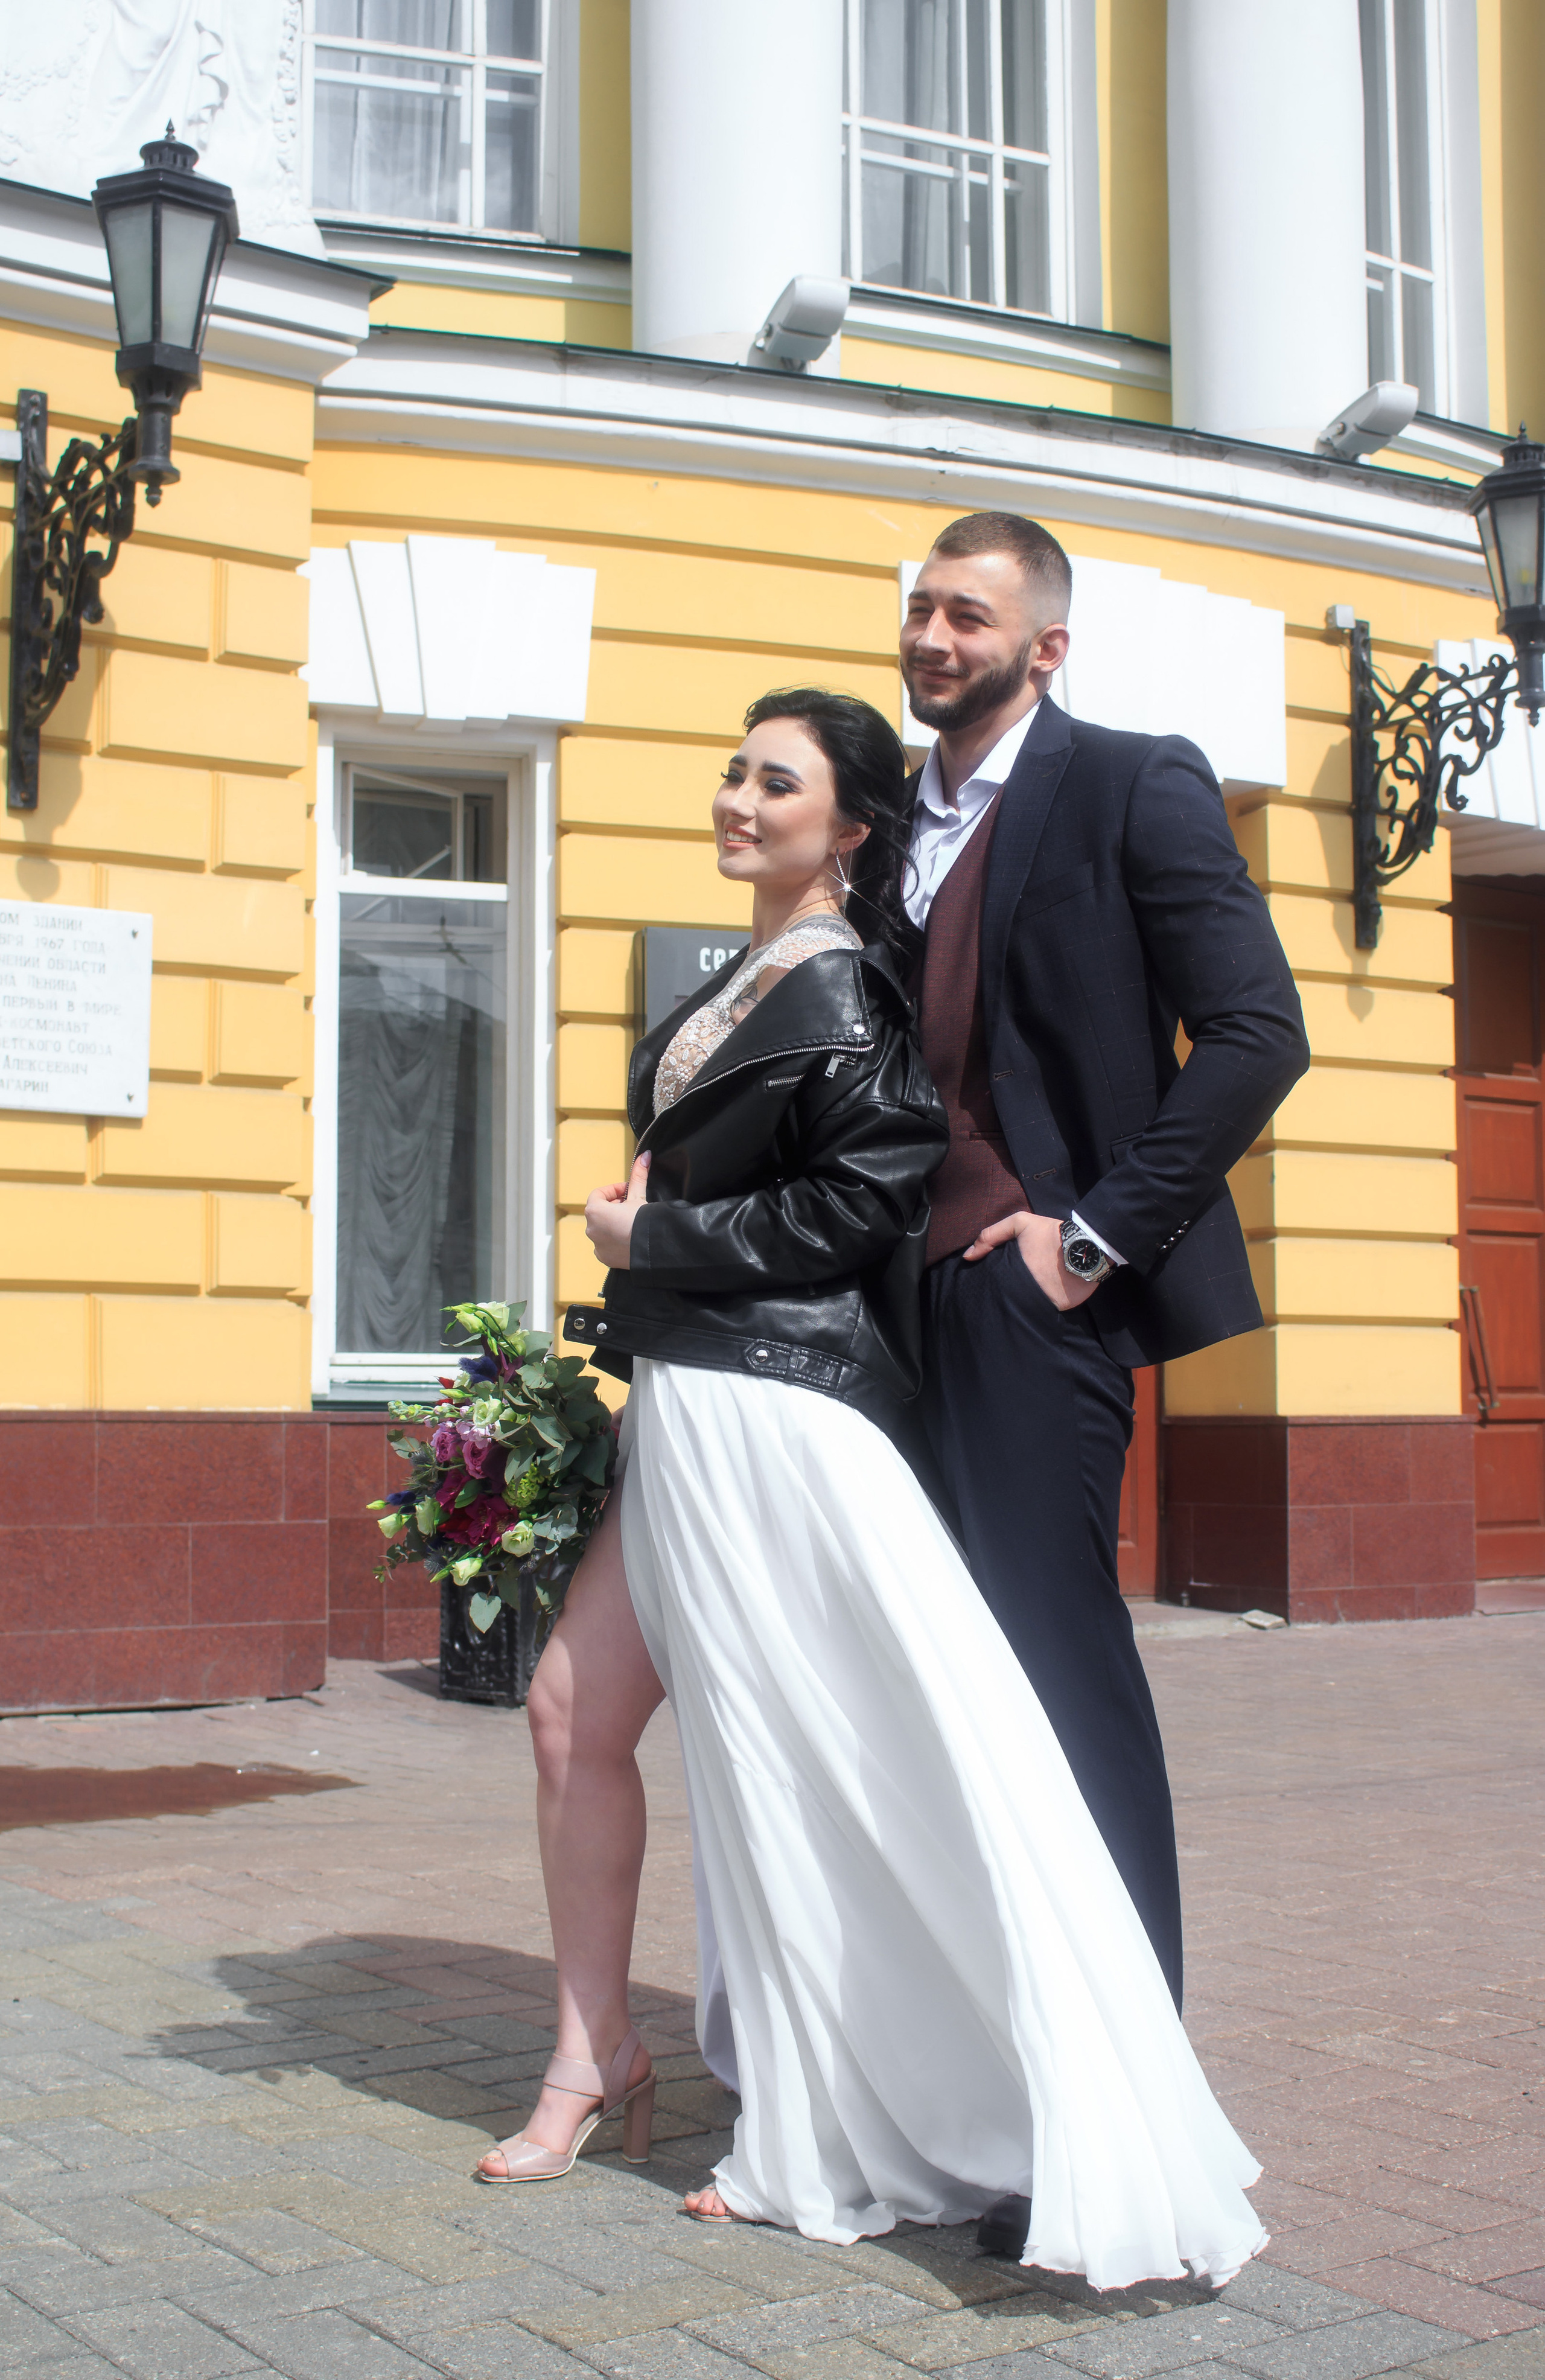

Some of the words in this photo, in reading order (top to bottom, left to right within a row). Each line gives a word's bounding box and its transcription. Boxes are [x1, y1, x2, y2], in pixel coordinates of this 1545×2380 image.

[33, 915, 82, 931] ЗДАНИИ
[36, 937, 63, 949] 1967
[73, 939, 106, 954] ГОДА
[47, 958, 106, 974] ОБЛАСТИ
[27, 974, 77, 992] ЛЕНИНА
[67, 1001, 74, 1012] В
[84, 1002, 121, 1016] МИРЕ
